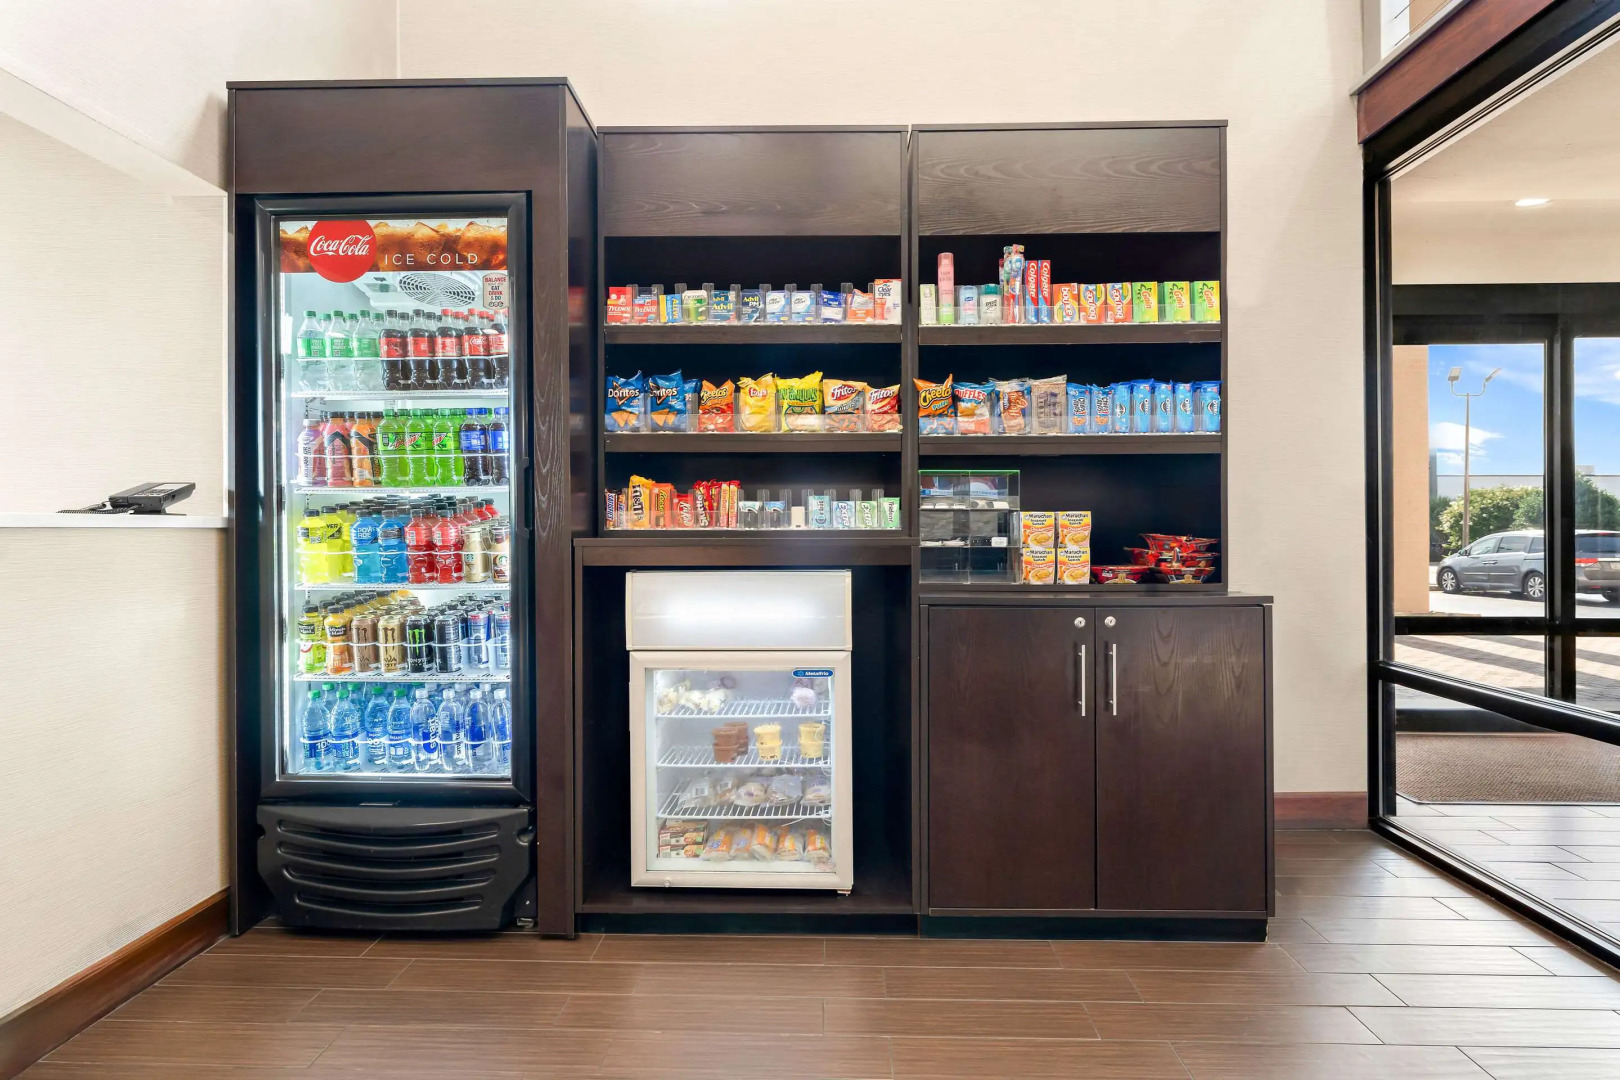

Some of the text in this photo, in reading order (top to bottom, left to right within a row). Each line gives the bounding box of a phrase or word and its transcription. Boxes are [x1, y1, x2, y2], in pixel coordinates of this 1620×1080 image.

[384, 253, 478, 265] ICE COLD
[1029, 262, 1037, 298] Colgate
[1042, 261, 1050, 298] Colgate
[712, 302, 734, 311] Advil
[1141, 290, 1152, 309] Gain
[1173, 290, 1184, 309] Gain
[1203, 289, 1214, 309] Gain
[608, 387, 639, 399] Doritos
[832, 384, 857, 401] Fritos
[869, 388, 895, 404] Fritos
[919, 383, 952, 408] Cheeto
